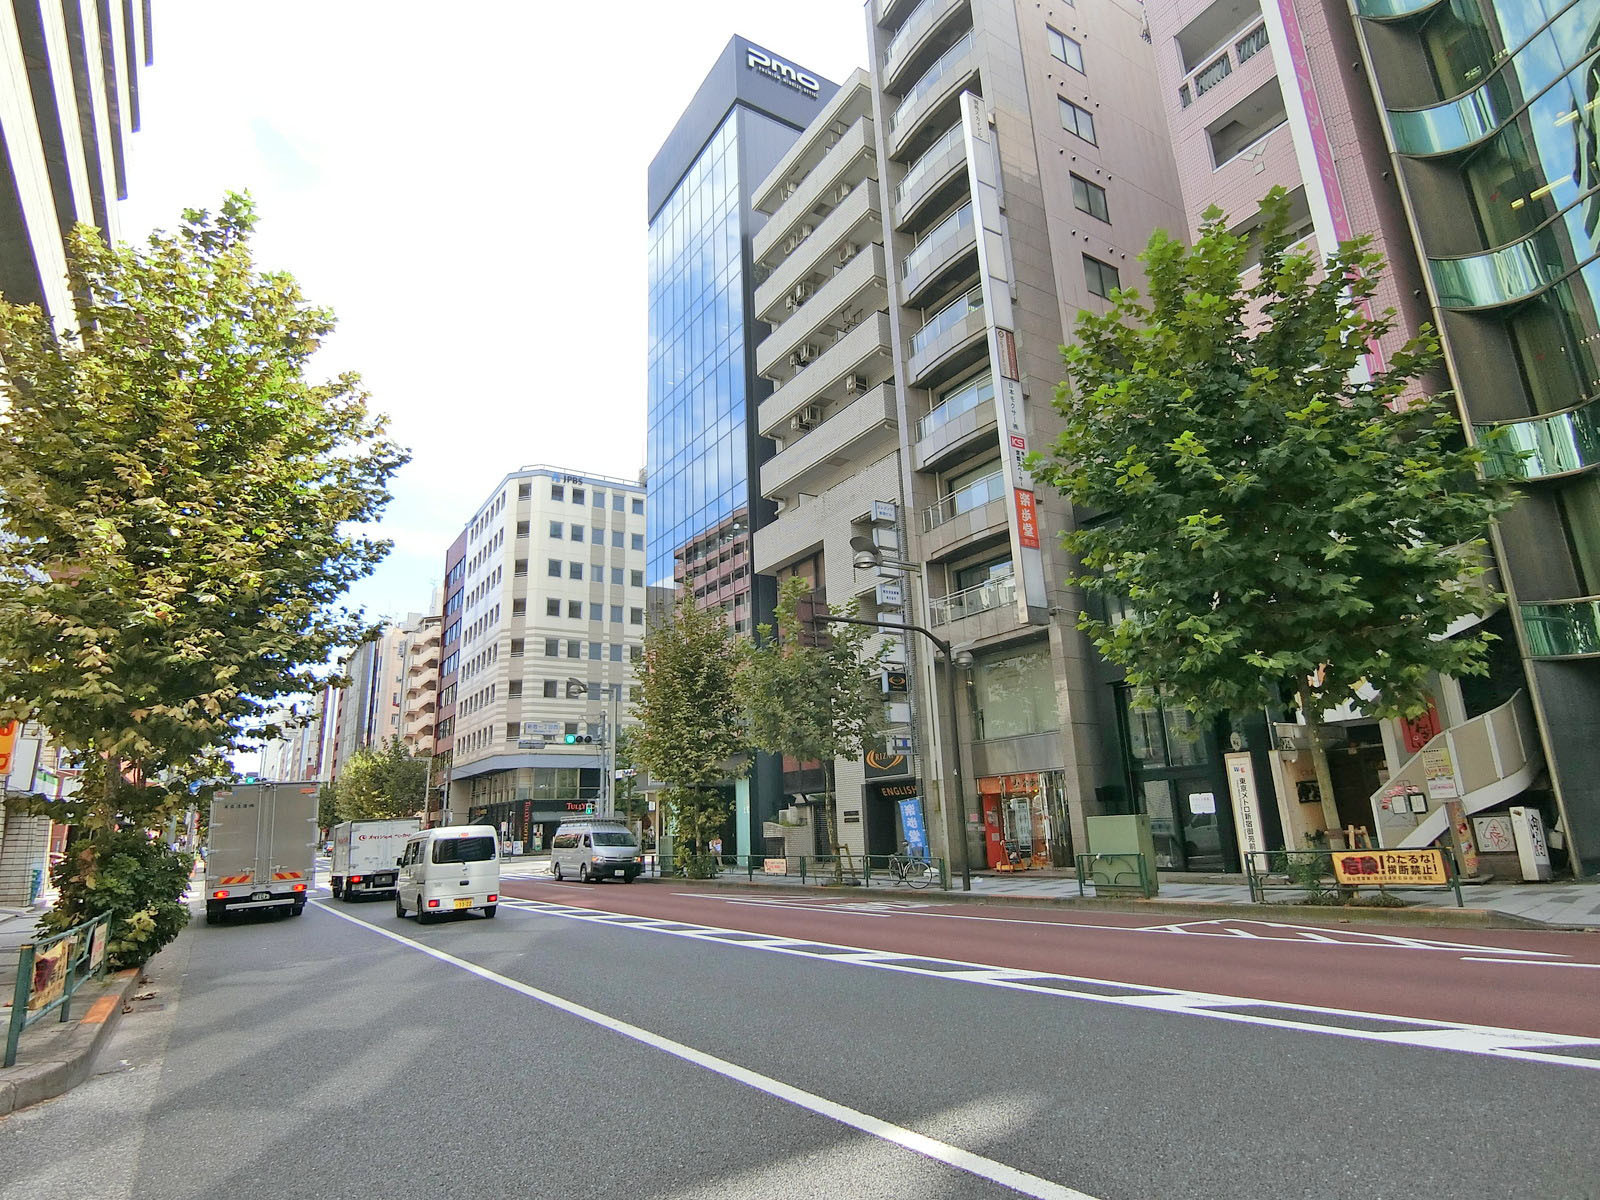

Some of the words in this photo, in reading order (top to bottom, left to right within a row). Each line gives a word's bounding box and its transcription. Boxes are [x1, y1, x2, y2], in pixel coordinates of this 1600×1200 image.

[563, 475, 584, 486] JPBS
[881, 786, 917, 797] ENGLISH
[1386, 853, 1435, 863] わたるな!
[1387, 864, 1438, 875] 横断禁止!
